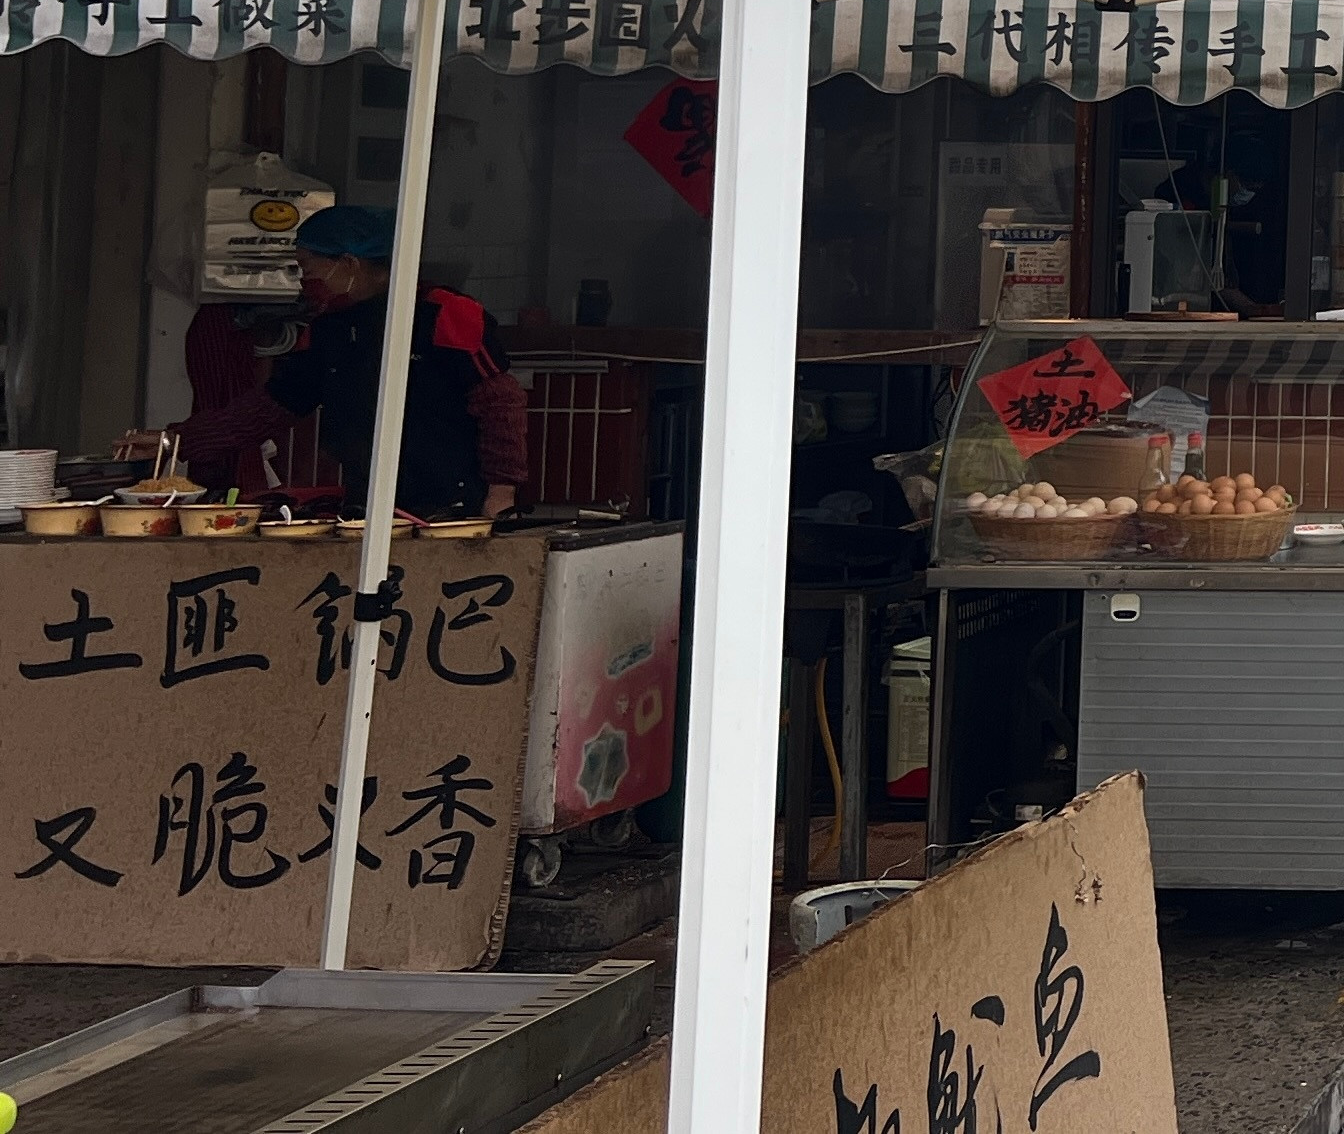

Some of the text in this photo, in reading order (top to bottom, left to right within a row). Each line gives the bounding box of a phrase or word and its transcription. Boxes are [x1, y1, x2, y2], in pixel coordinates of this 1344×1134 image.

[1032, 349, 1097, 380] 土
[17, 564, 518, 690] 土匪锅巴
[13, 751, 497, 899] 又脆又香
